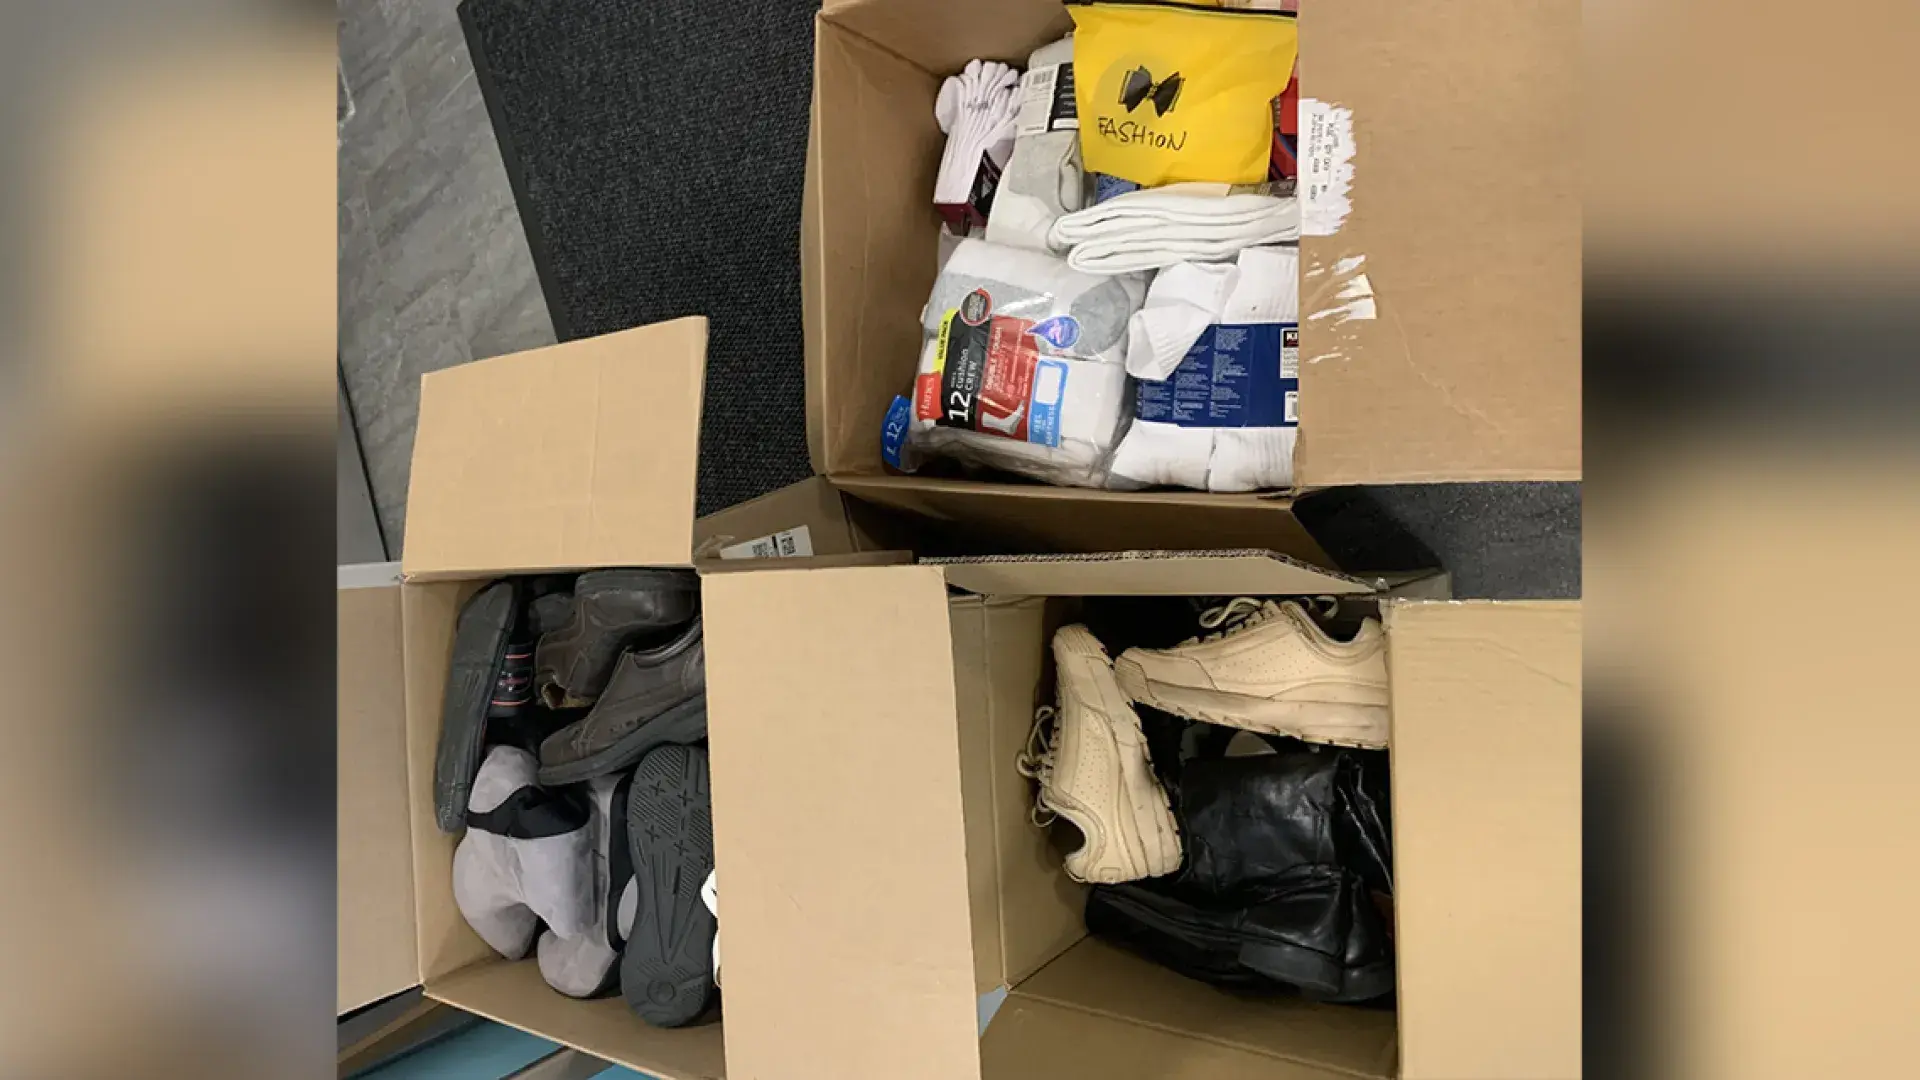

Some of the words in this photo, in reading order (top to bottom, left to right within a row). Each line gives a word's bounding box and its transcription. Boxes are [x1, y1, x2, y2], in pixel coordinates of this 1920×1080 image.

[956, 349, 968, 389] cushion
[965, 361, 977, 391] CREW
[919, 377, 935, 415] Hanes
[948, 391, 971, 422] 12
[886, 422, 903, 440] 12
